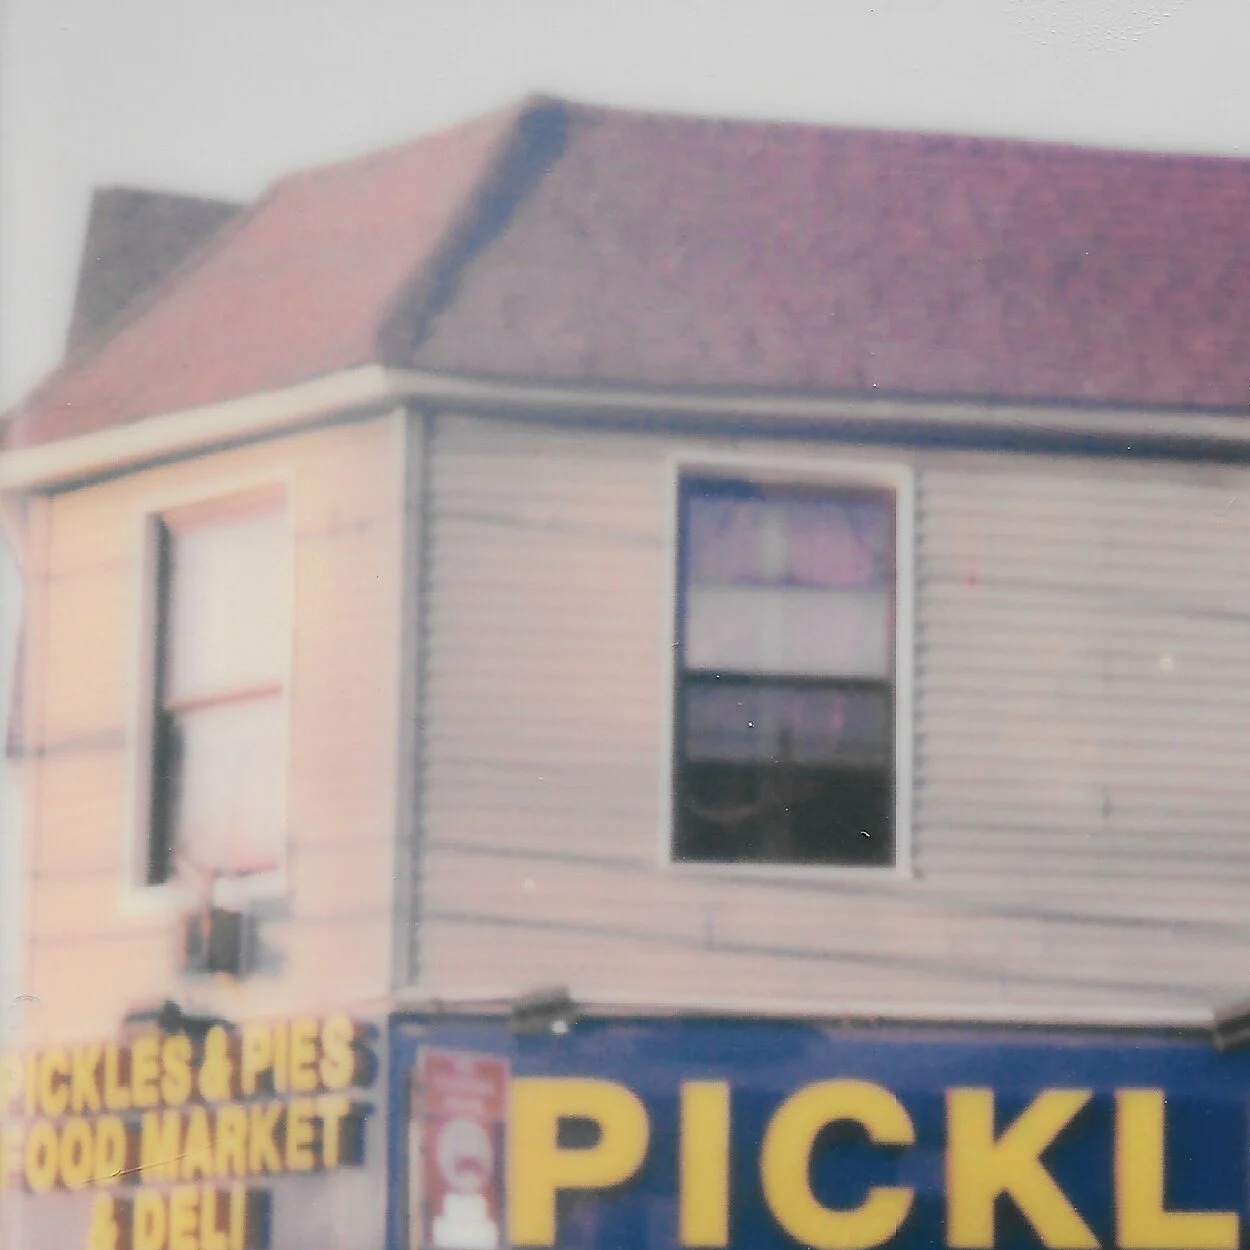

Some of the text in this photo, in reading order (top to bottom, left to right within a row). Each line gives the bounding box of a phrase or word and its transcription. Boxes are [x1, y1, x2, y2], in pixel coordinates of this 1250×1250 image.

[0, 1034, 192, 1117] PICKLES
[199, 1025, 231, 1101] &
[241, 1014, 355, 1097] PIES
[140, 1097, 348, 1182] MARKET
